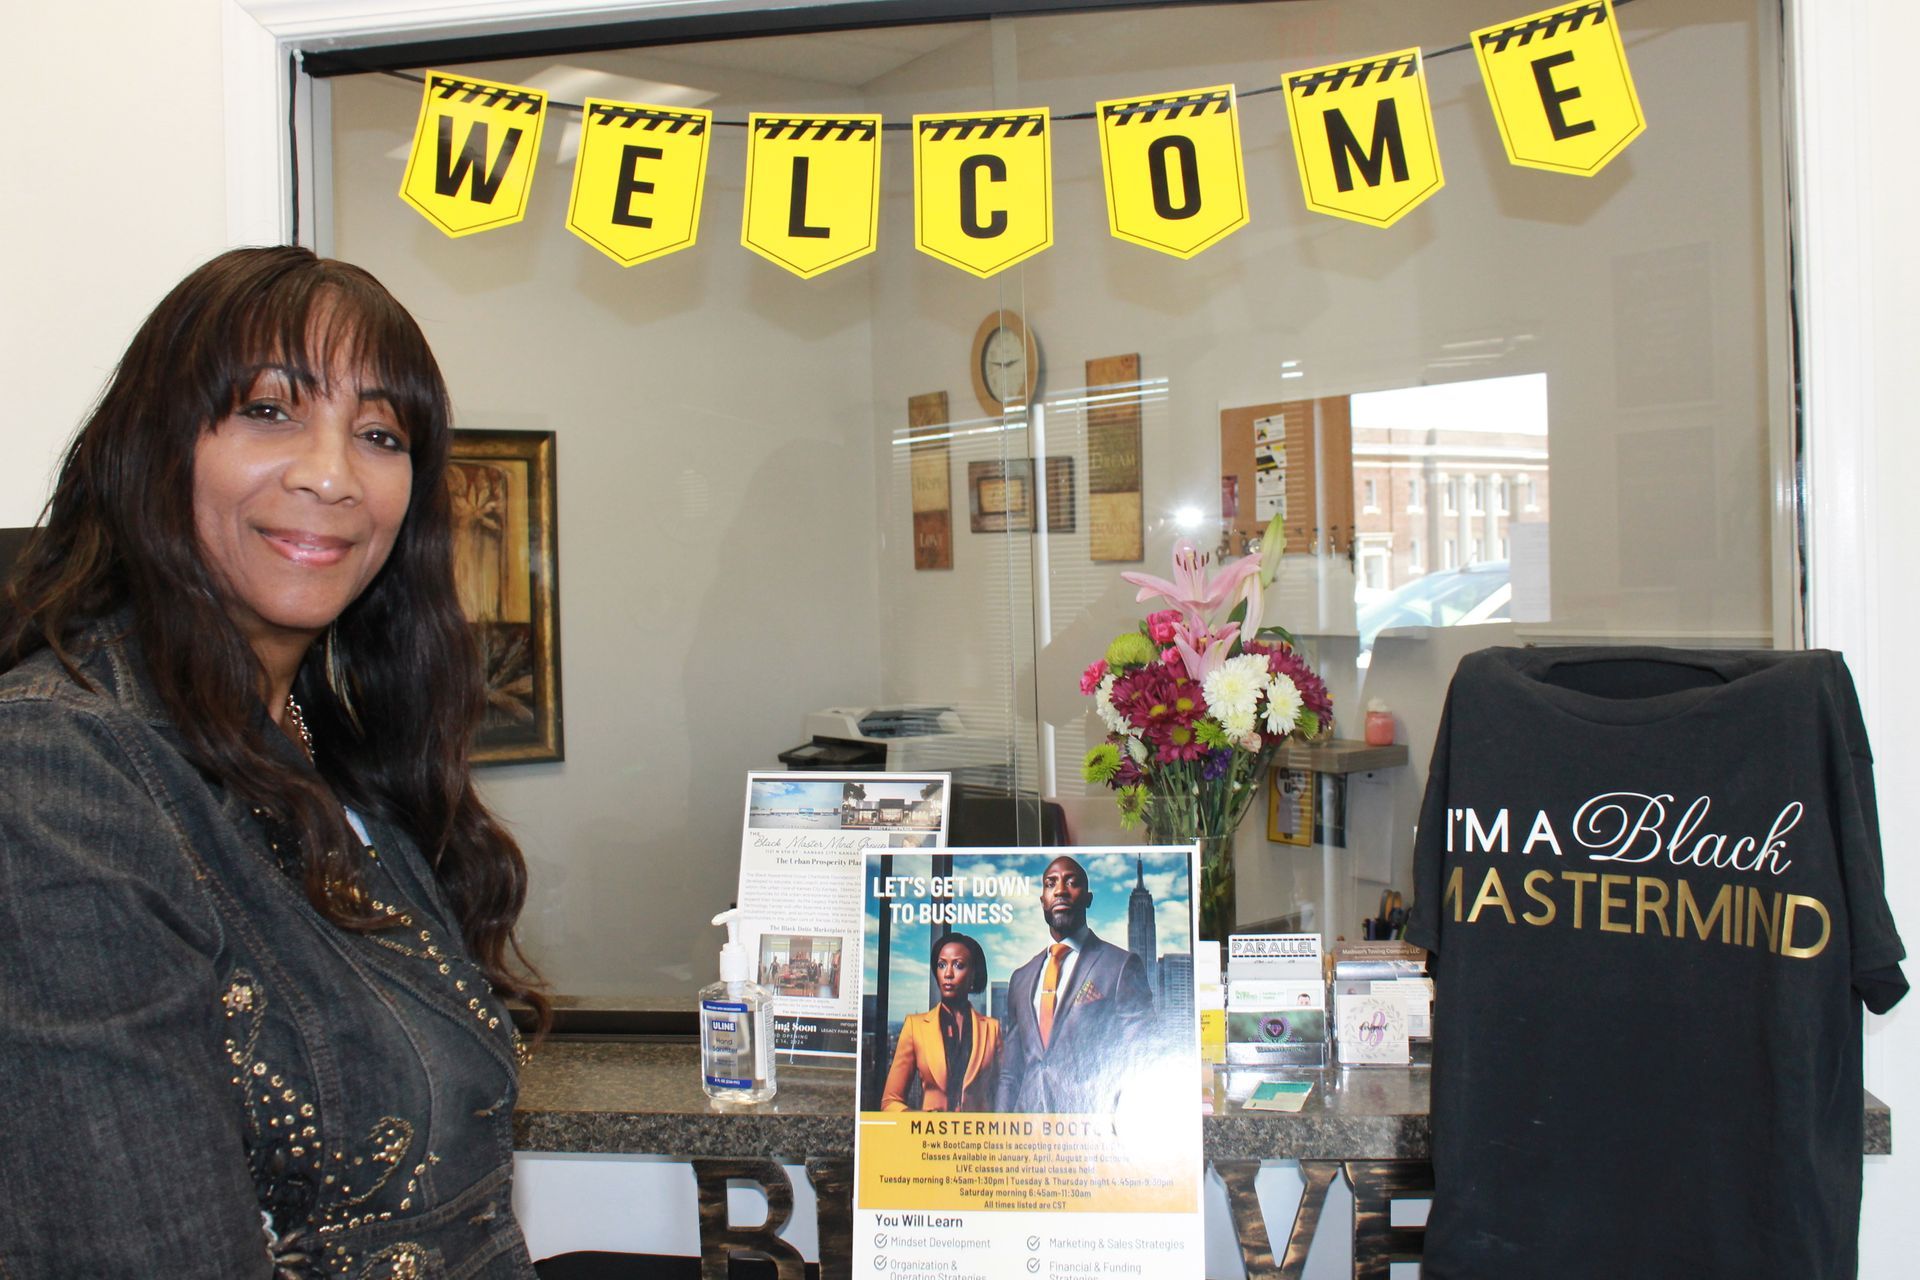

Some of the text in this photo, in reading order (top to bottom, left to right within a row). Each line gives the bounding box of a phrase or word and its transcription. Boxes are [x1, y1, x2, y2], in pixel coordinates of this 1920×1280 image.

[1446, 791, 1804, 875] I'M A Black
[753, 834, 782, 848] Black
[811, 858, 847, 867] Prosperity
[873, 876, 1030, 898] LET'S GET DOWN
[889, 902, 1014, 924] TO BUSINESS
[1231, 941, 1316, 954] PARALLEL
[712, 1021, 735, 1031] ULINE
[792, 1021, 817, 1033] Soon
[911, 1120, 1033, 1136] MASTERMIND
[922, 1140, 941, 1149] 8-wk
[943, 1141, 982, 1151] BootCamp
[983, 1141, 1004, 1150] Class
[1005, 1142, 1012, 1150] is
[1014, 1142, 1051, 1152] accepting
[921, 1153, 951, 1161] Classes
[952, 1153, 987, 1162] Available
[988, 1154, 996, 1162] in
[1055, 1154, 1082, 1164] August
[956, 1164, 973, 1173] LIVE
[974, 1165, 1004, 1173] classes
[1005, 1165, 1019, 1174] and
[1021, 1166, 1046, 1174] virtual
[1047, 1166, 1077, 1174] classes
[879, 1174, 911, 1185] Tuesday
[912, 1176, 944, 1185] morning
[1010, 1178, 1042, 1187] Tuesday
[1044, 1178, 1050, 1186] &
[1052, 1178, 1088, 1187] Thursday
[1089, 1178, 1110, 1188] night
[959, 1188, 994, 1197] Saturday
[995, 1189, 1027, 1198] morning
[984, 1200, 994, 1209] All
[995, 1200, 1015, 1209] times
[1016, 1201, 1037, 1209] listed
[1052, 1201, 1066, 1209] CST
[875, 1214, 963, 1228] You Will Learn
[890, 1236, 991, 1250] Mindset Development
[1049, 1238, 1185, 1252] Marketing & Sales Strategies
[890, 1260, 958, 1272] Organization &
[1049, 1261, 1142, 1274] Financial & Funding
[890, 1272, 938, 1280] Operation
